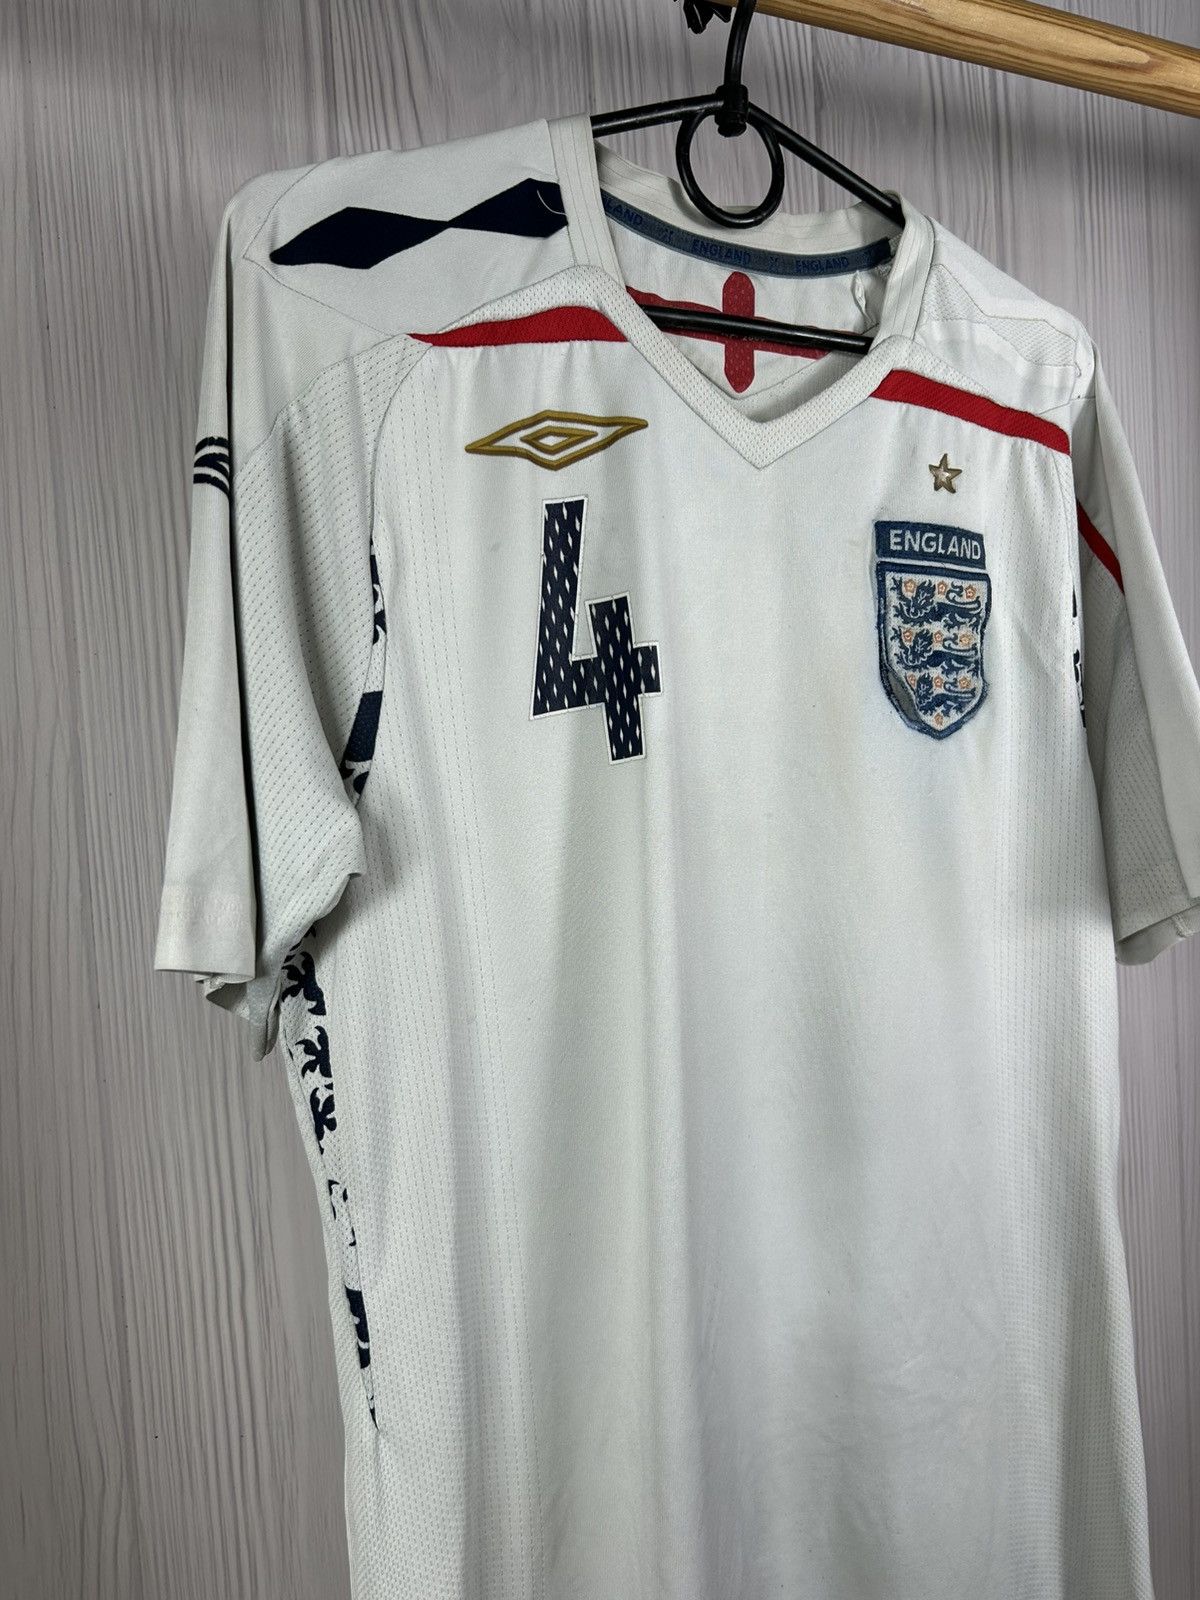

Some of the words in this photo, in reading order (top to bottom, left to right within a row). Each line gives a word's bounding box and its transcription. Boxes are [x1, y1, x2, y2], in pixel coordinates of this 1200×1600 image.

[603, 197, 643, 226] LAND
[692, 239, 751, 265] ENGLAND
[794, 256, 849, 273] ENGLAND
[889, 529, 981, 560] ENGLAND
[529, 495, 662, 765] 4
